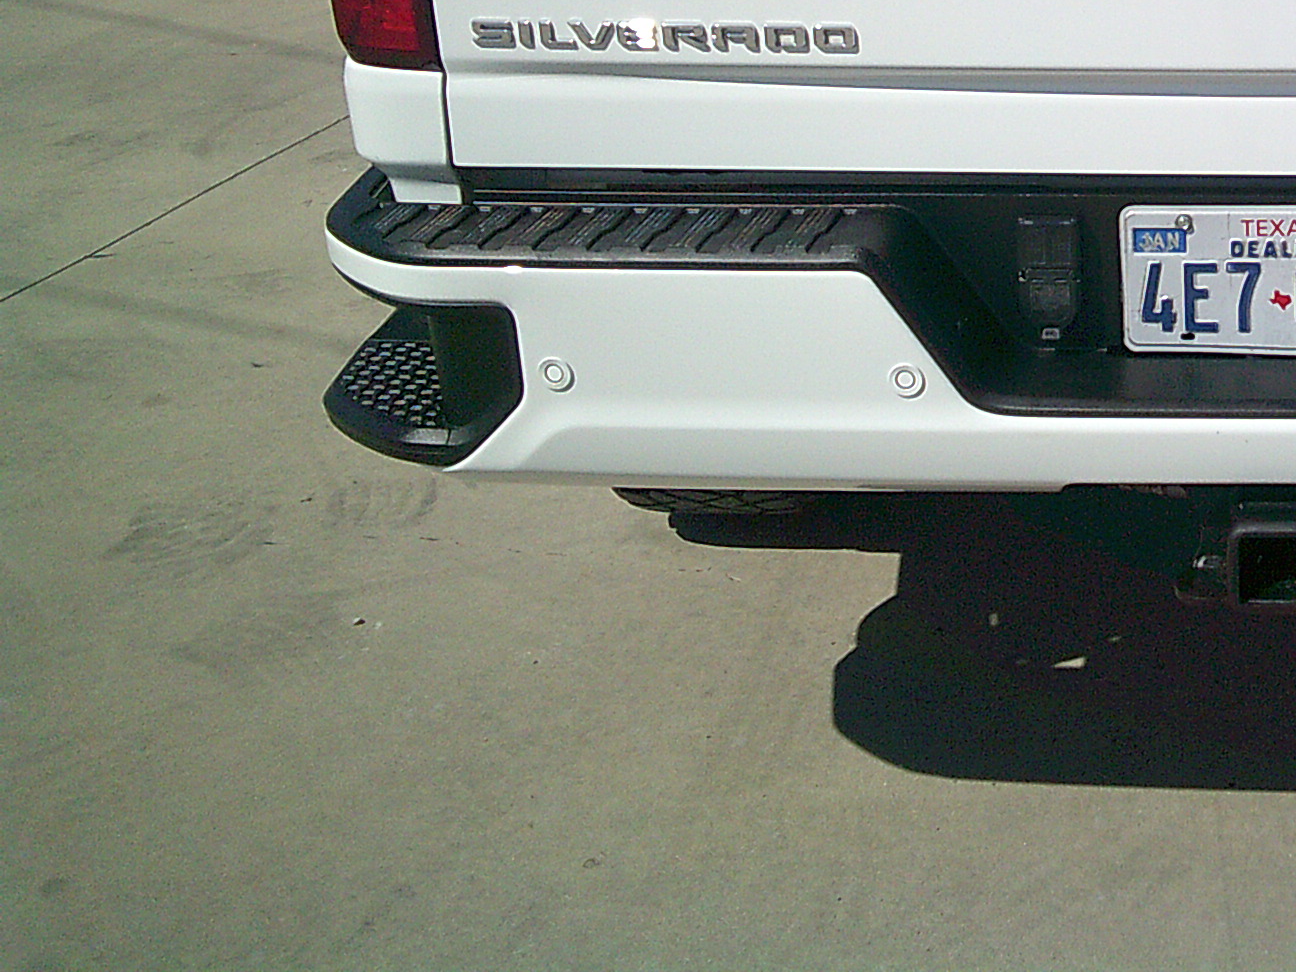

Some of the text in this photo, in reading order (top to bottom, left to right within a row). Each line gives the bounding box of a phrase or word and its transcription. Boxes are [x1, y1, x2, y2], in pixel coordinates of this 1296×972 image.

[470, 15, 860, 55] SILVERADO
[1138, 231, 1180, 251] JAN
[1141, 261, 1262, 333] 4E7
